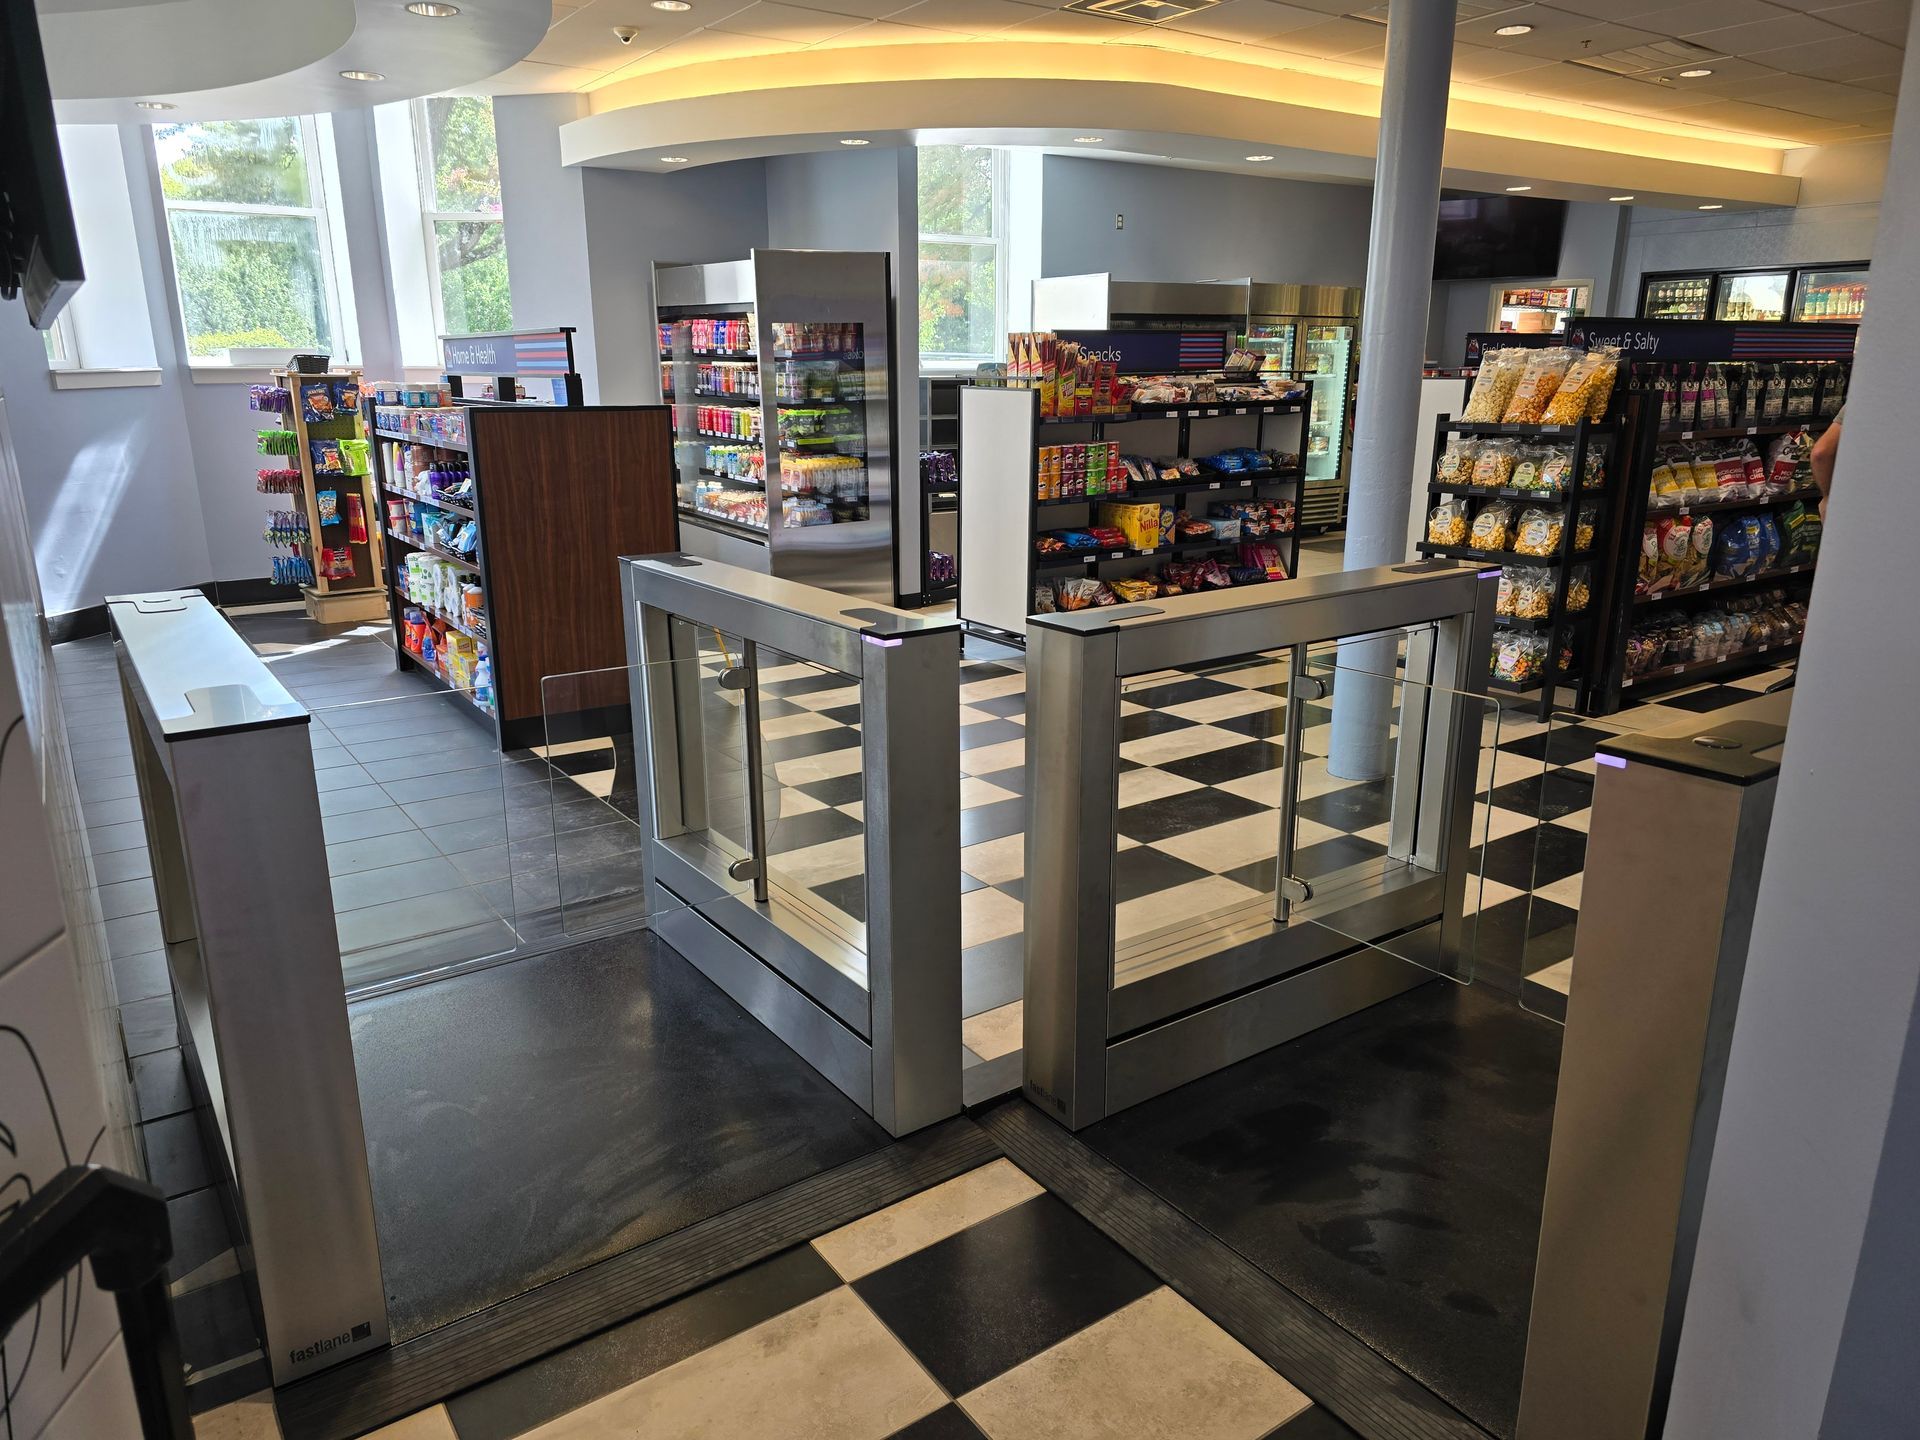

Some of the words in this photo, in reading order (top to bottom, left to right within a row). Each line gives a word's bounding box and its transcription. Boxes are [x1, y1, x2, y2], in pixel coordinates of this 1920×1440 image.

[451, 345, 469, 365] Home
[469, 345, 475, 365] &
[475, 343, 497, 365] Health
[1079, 345, 1122, 362] Snacks
[1588, 331, 1621, 350] Sweet
[1623, 331, 1632, 350] &
[1633, 331, 1660, 355] Salty
[1140, 518, 1158, 533] Nilla
[289, 1332, 351, 1364] fastlane
